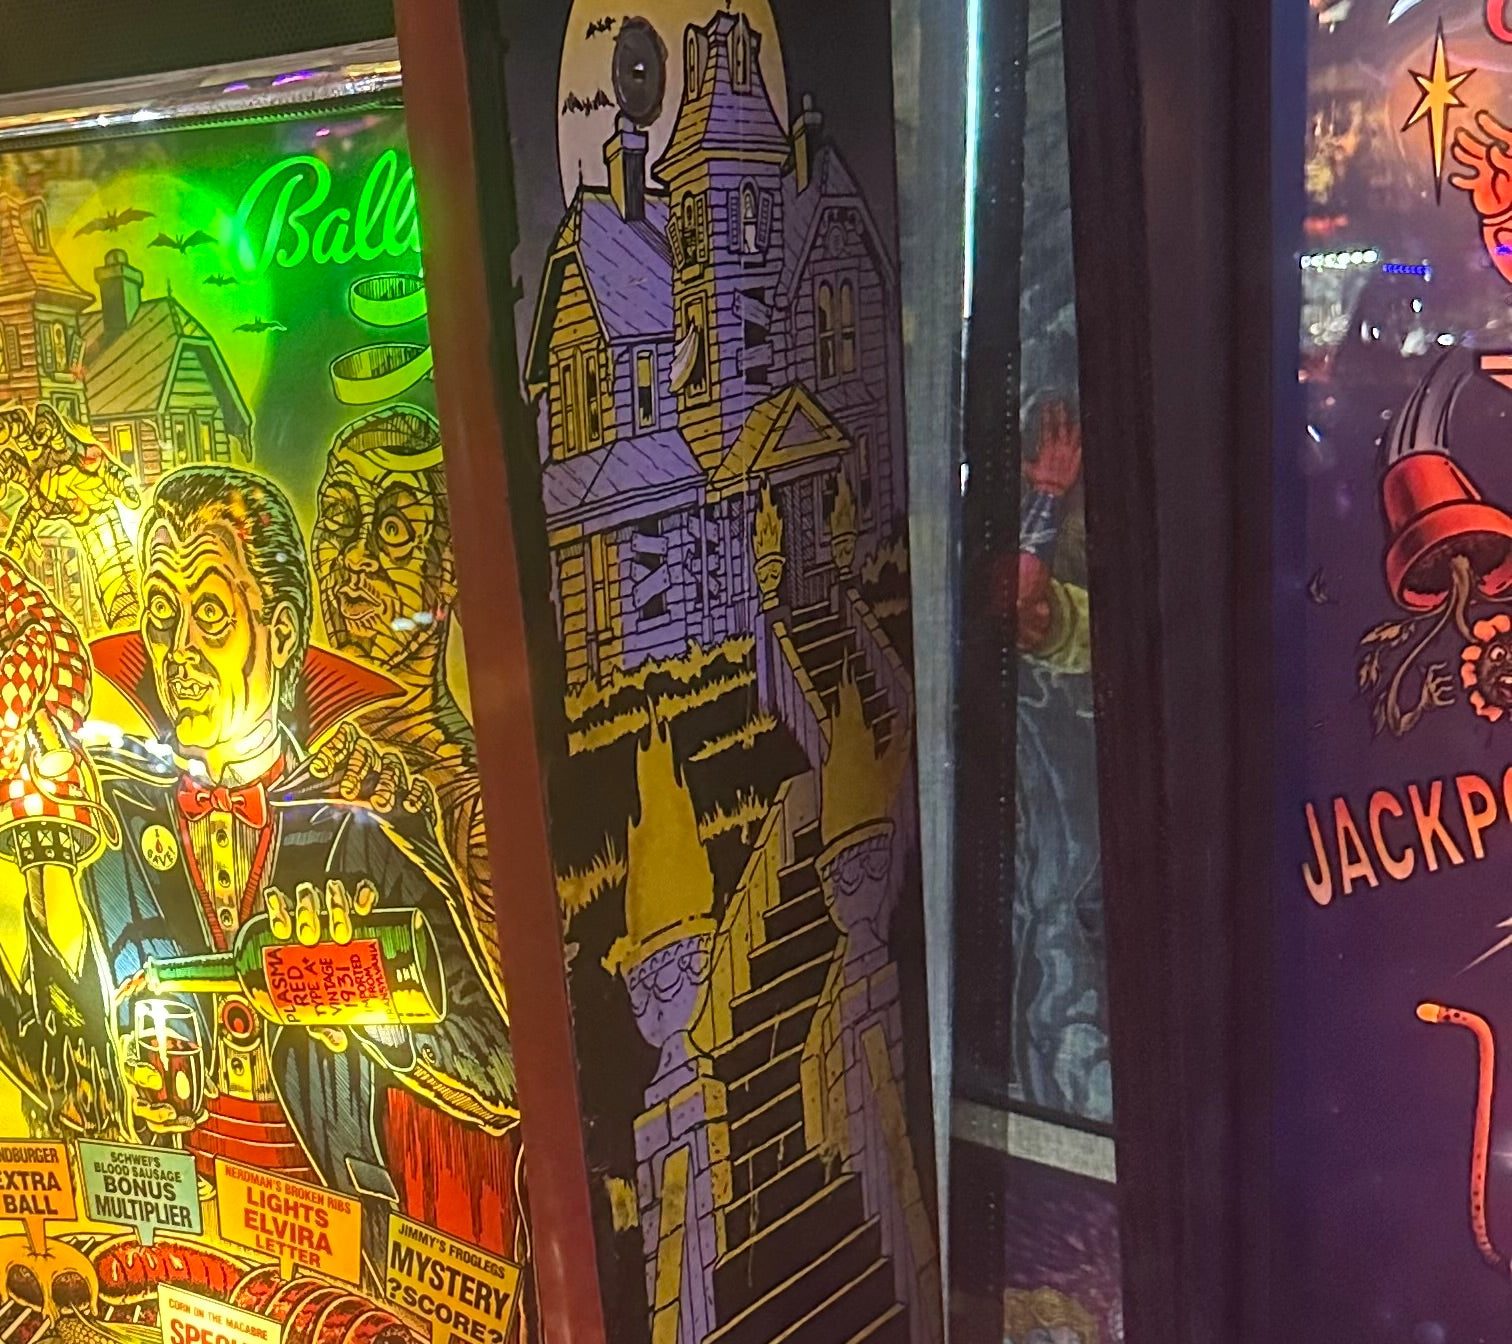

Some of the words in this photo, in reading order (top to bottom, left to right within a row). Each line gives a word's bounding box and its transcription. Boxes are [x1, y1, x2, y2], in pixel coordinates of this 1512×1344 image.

[1300, 768, 1512, 906] JACKP
[267, 948, 302, 1023] PLASMA
[287, 965, 311, 1007] RED
[307, 981, 327, 1016] TYPE
[319, 957, 343, 1016] VINTAGE
[335, 966, 359, 1008] 1931
[350, 953, 374, 1012] IMPORTED
[363, 966, 378, 999] FROM
[94, 1162, 130, 1176] BLOOD
[131, 1166, 183, 1183] SAUSAGE
[103, 1174, 177, 1202] BONUS
[225, 1166, 283, 1193] NERDMAN'S
[284, 1180, 325, 1206] BROKEN
[327, 1196, 352, 1215] RIBS
[2, 1194, 59, 1216] BALL
[94, 1194, 193, 1229] MULTIPLIER
[246, 1186, 330, 1229] LIGHTS
[243, 1207, 334, 1256] ELVIRA
[255, 1233, 321, 1269] LETTER
[398, 1223, 447, 1254] JIMMY'S
[449, 1244, 506, 1280] FROGLEGS
[390, 1240, 511, 1321] MYSTERY
[168, 1298, 191, 1314] CORN
[193, 1308, 205, 1319] ON
[208, 1311, 222, 1326] THE
[225, 1317, 269, 1340] MACABRE
